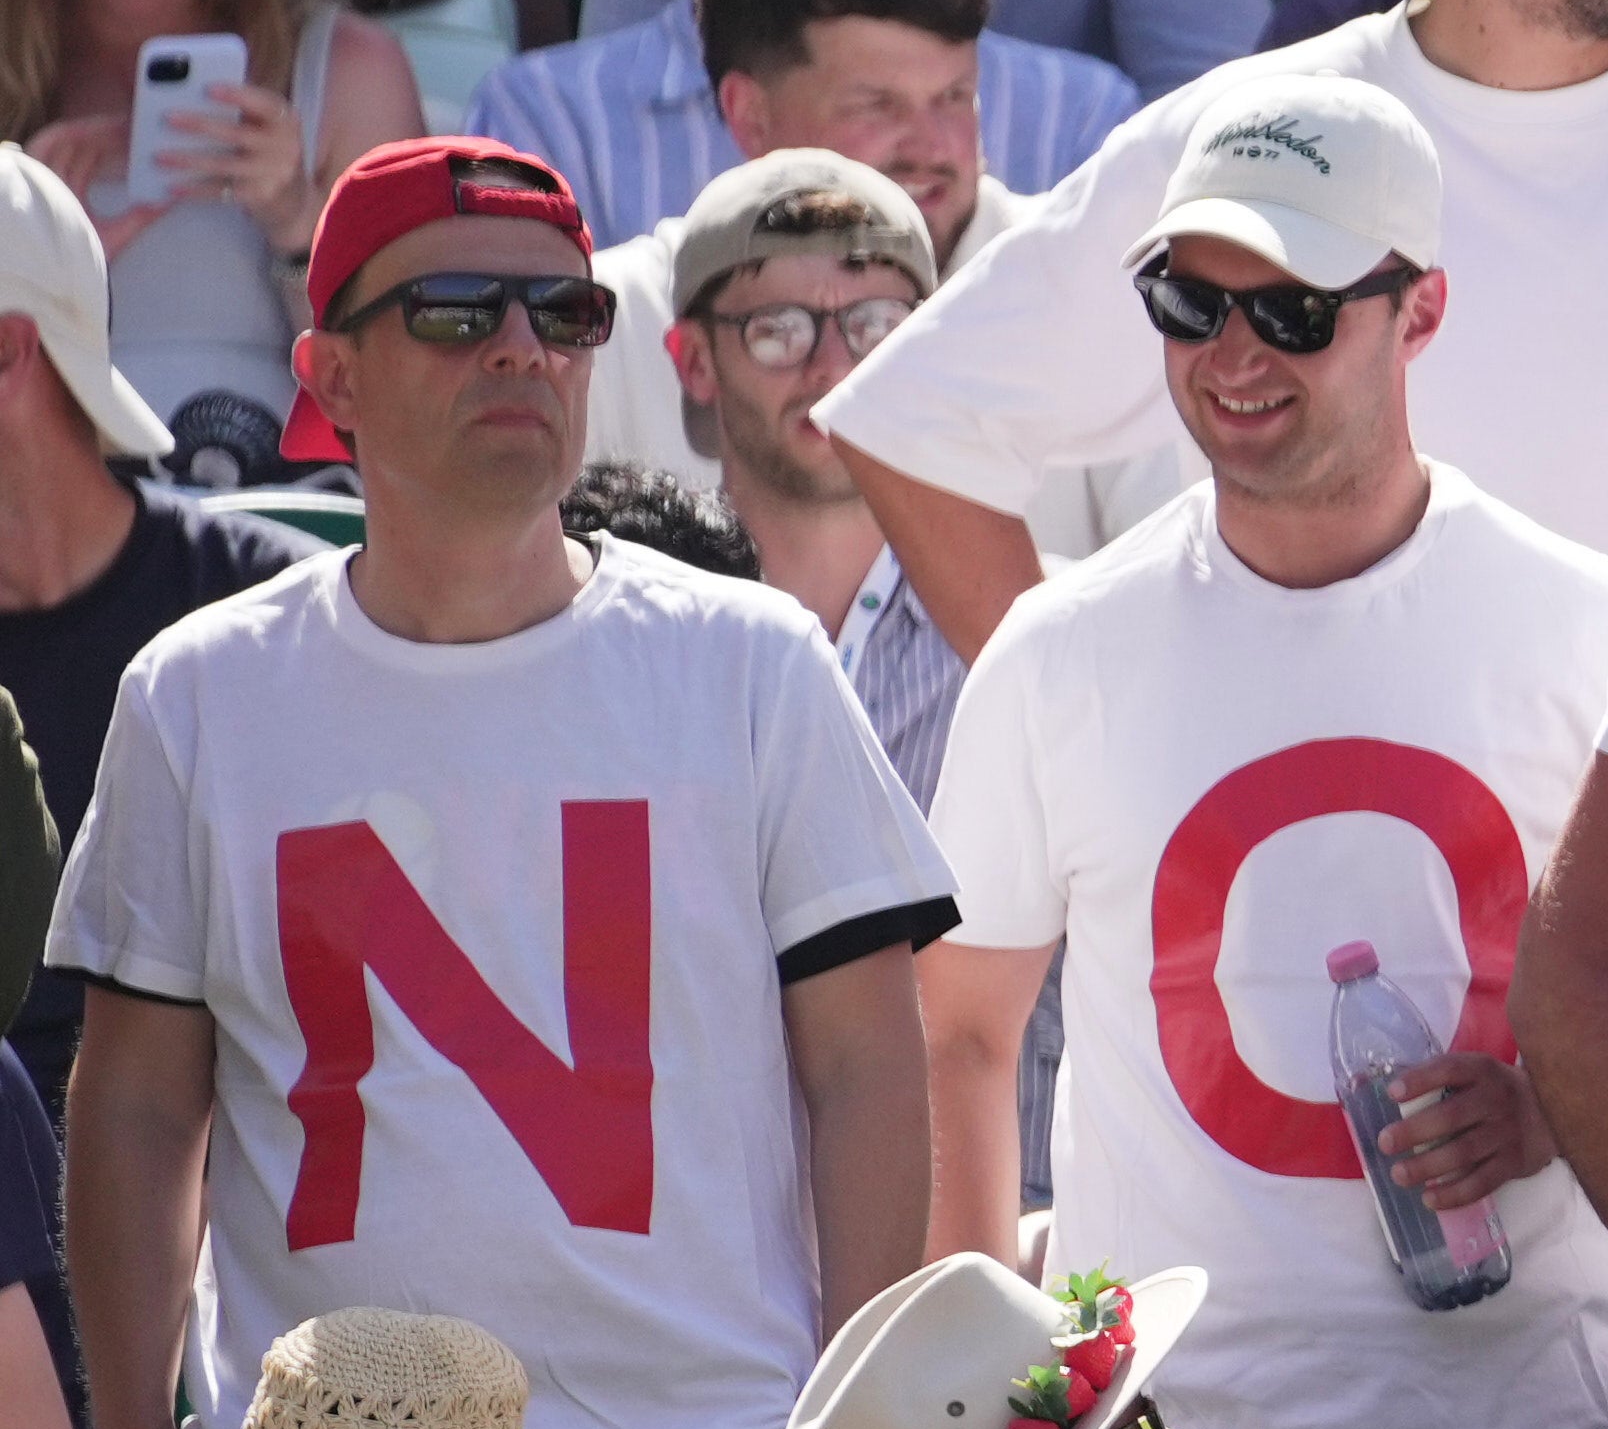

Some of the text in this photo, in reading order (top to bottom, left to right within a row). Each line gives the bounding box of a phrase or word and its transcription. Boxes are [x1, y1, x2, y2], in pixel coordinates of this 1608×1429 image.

[1199, 112, 1330, 175] Wimbledon
[277, 799, 655, 1253] N
[1150, 735, 1529, 1180] O
